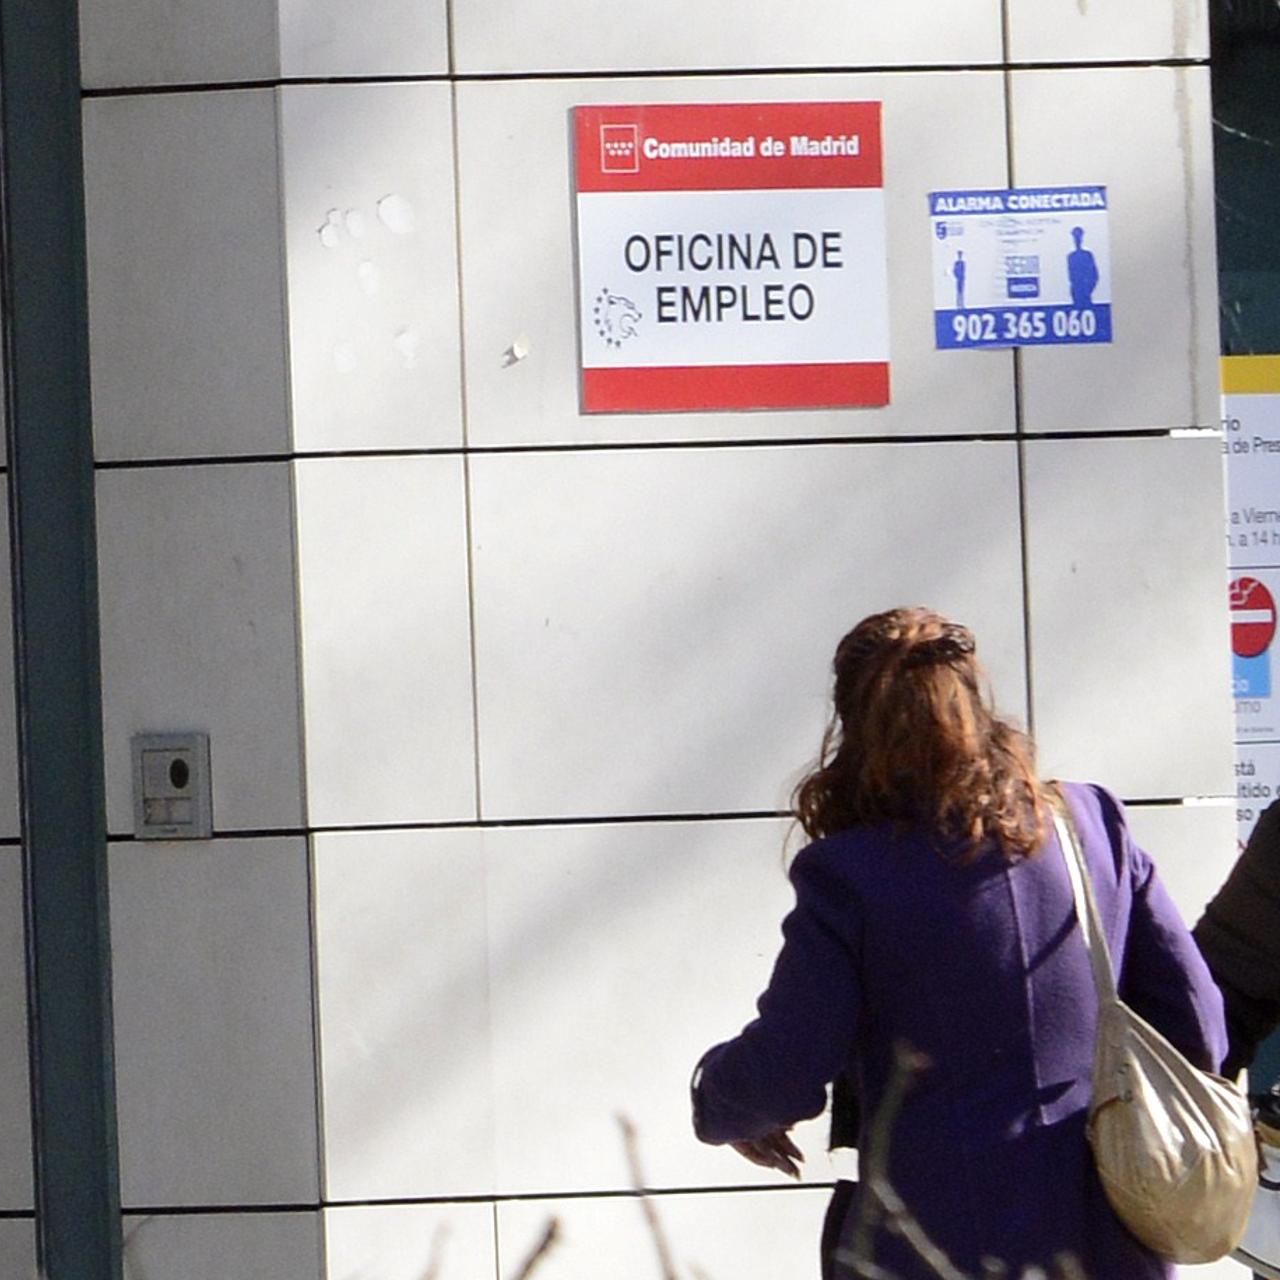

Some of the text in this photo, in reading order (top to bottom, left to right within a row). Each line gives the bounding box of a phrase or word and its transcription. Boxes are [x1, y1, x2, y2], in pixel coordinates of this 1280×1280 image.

[643, 135, 859, 159] Comunidad de Madrid
[935, 191, 1105, 213] ALARMA CONECTADA
[624, 232, 843, 271] OFICINA DE
[656, 283, 815, 323] EMPLEO
[952, 310, 1096, 342] 902 365 060
